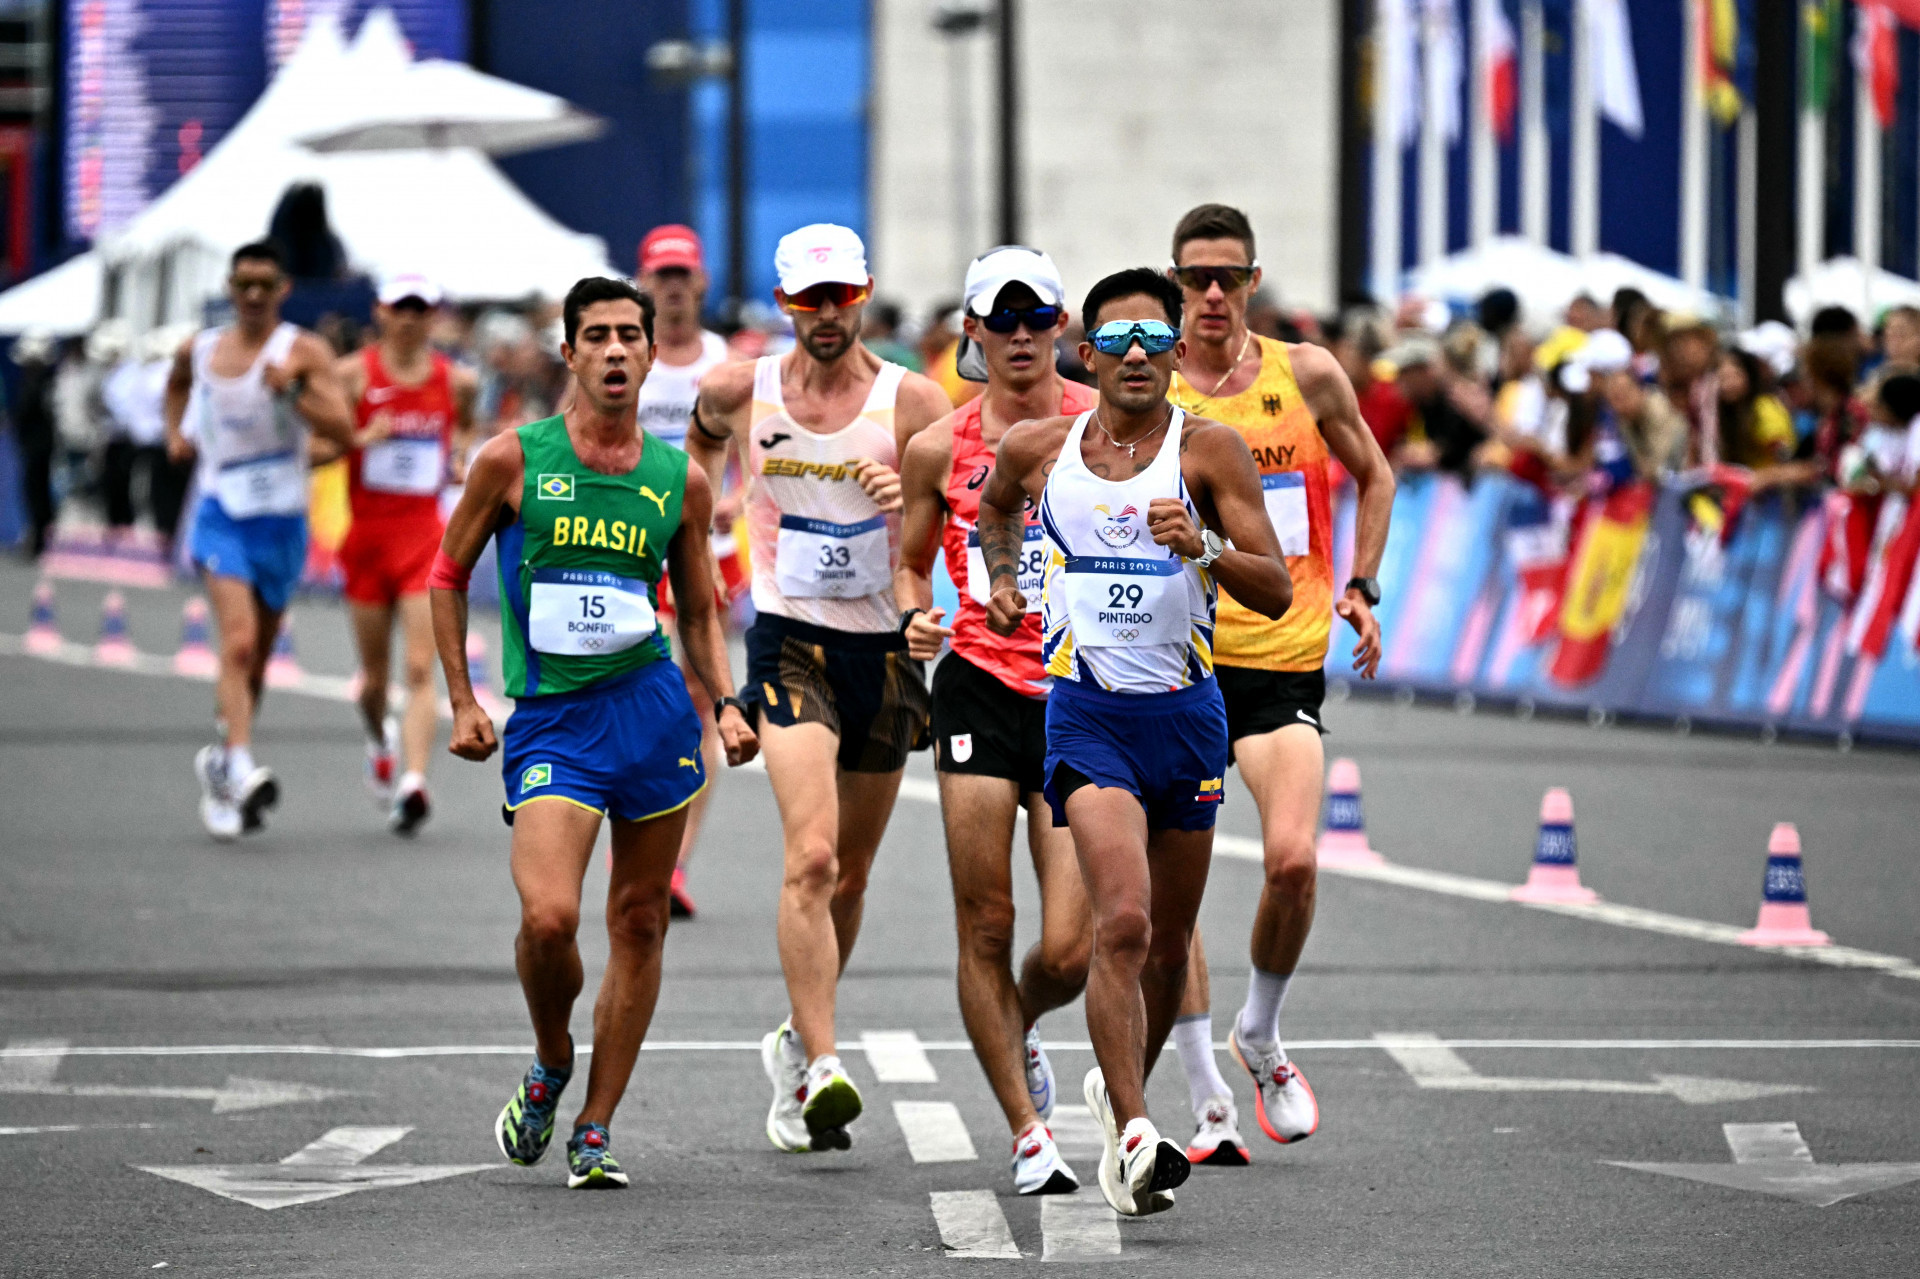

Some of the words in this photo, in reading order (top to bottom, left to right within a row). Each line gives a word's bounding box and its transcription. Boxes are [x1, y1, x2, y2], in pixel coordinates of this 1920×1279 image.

[762, 458, 862, 482] ESPAÑ
[553, 516, 647, 558] BRASIL
[820, 545, 851, 567] 33
[1094, 561, 1126, 570] PARIS
[1129, 563, 1158, 571] 2024
[562, 572, 594, 582] PARIS
[596, 574, 622, 586] 2024
[579, 595, 606, 619] 15
[1107, 583, 1144, 609] 29
[568, 621, 616, 634] BONFIM
[1098, 611, 1153, 624] PINTADO
